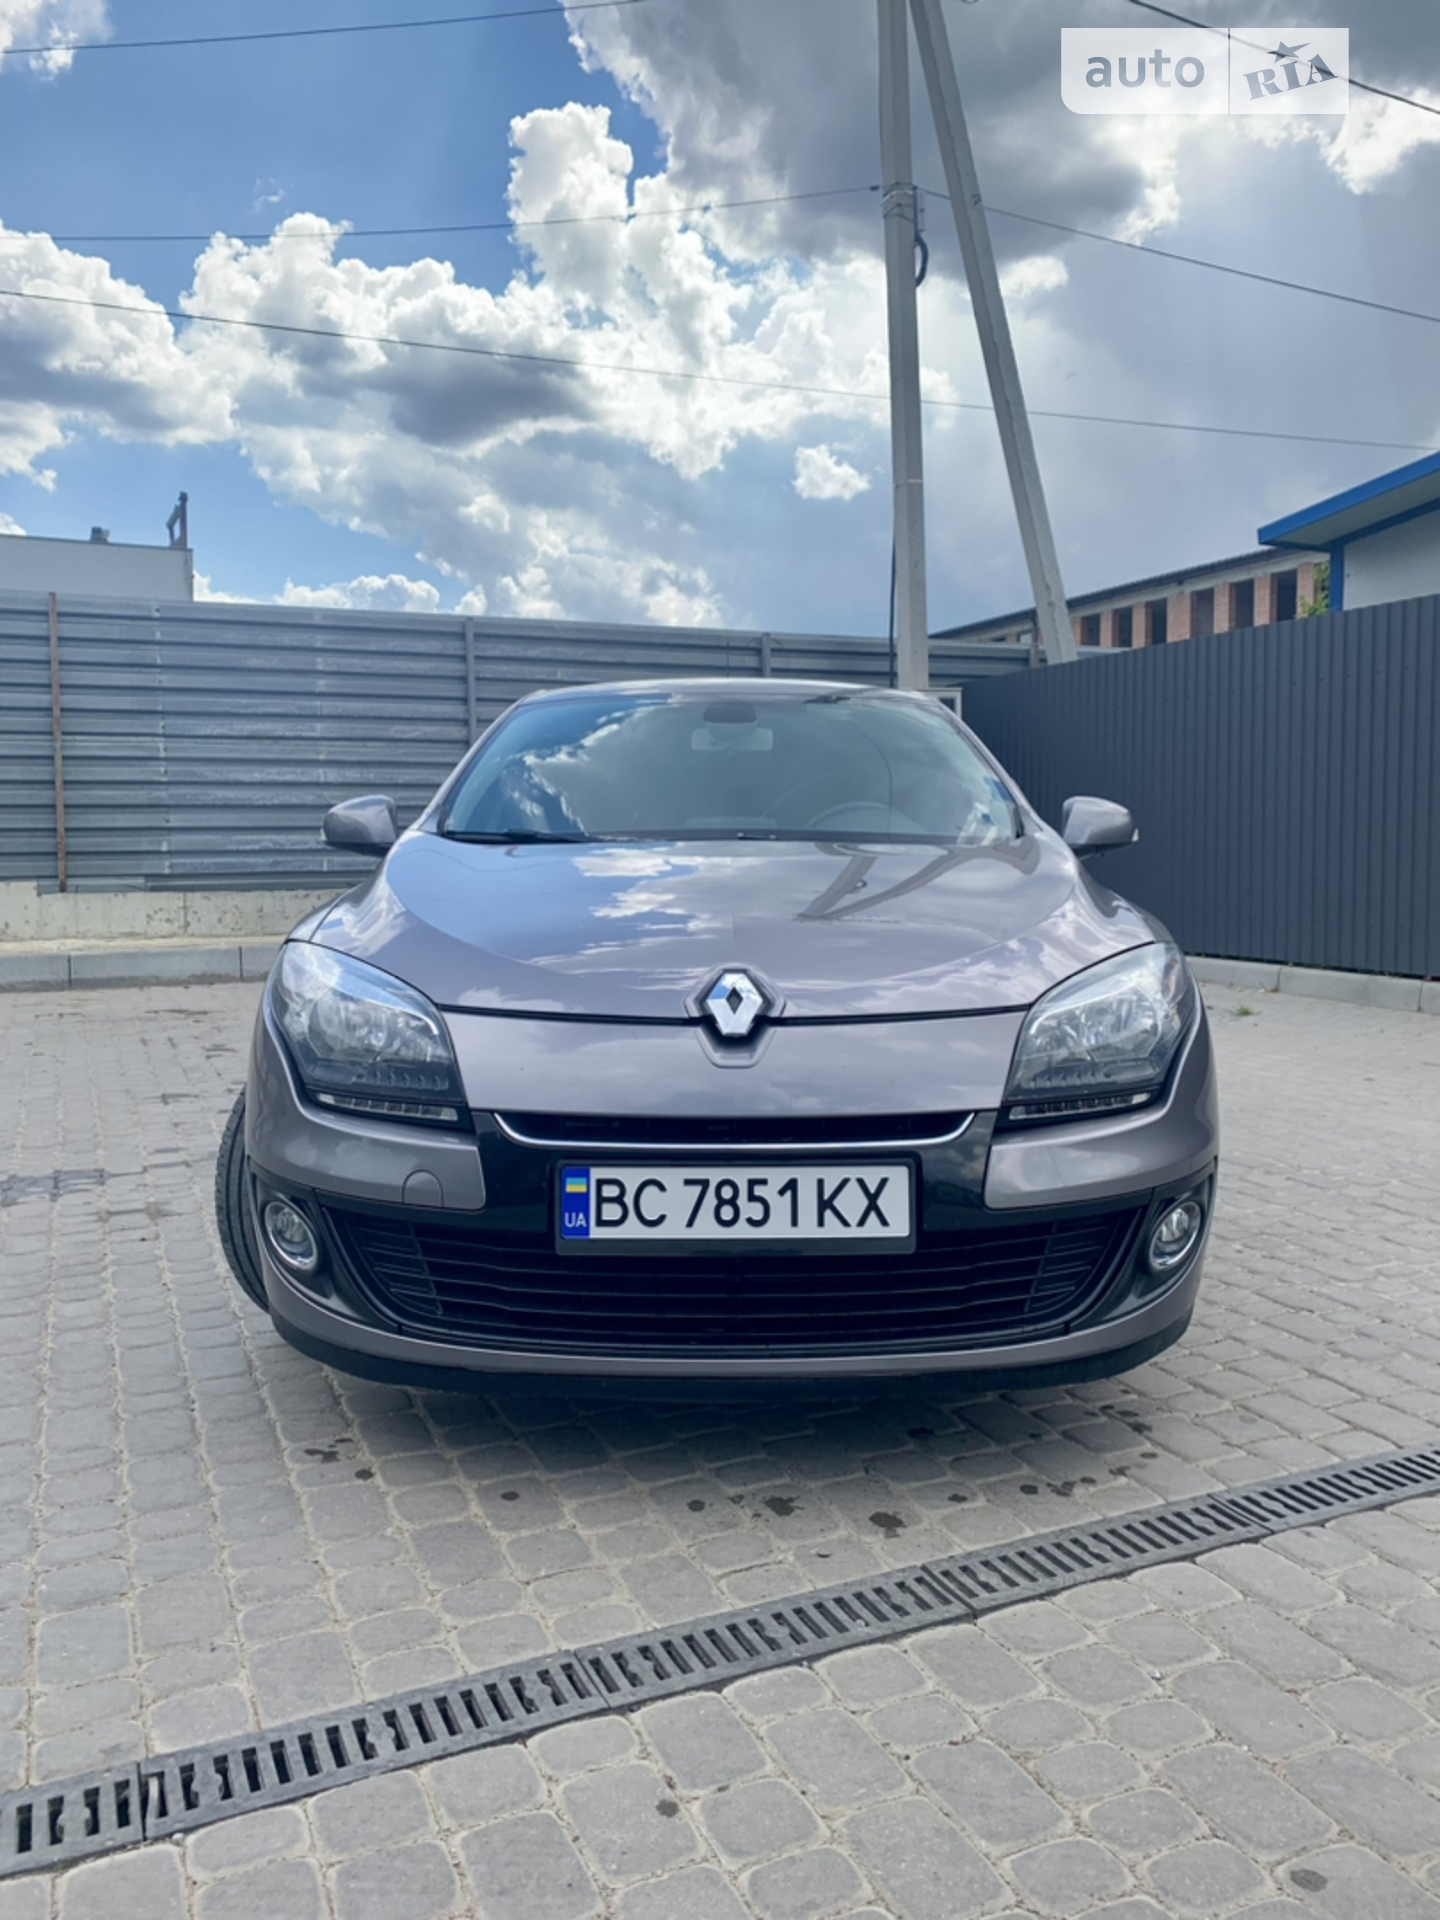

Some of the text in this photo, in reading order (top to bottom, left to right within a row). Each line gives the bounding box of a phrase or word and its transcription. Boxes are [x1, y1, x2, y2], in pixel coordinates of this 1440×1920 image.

[563, 1211, 588, 1228] UA
[594, 1177, 890, 1228] BC 7851 KX
